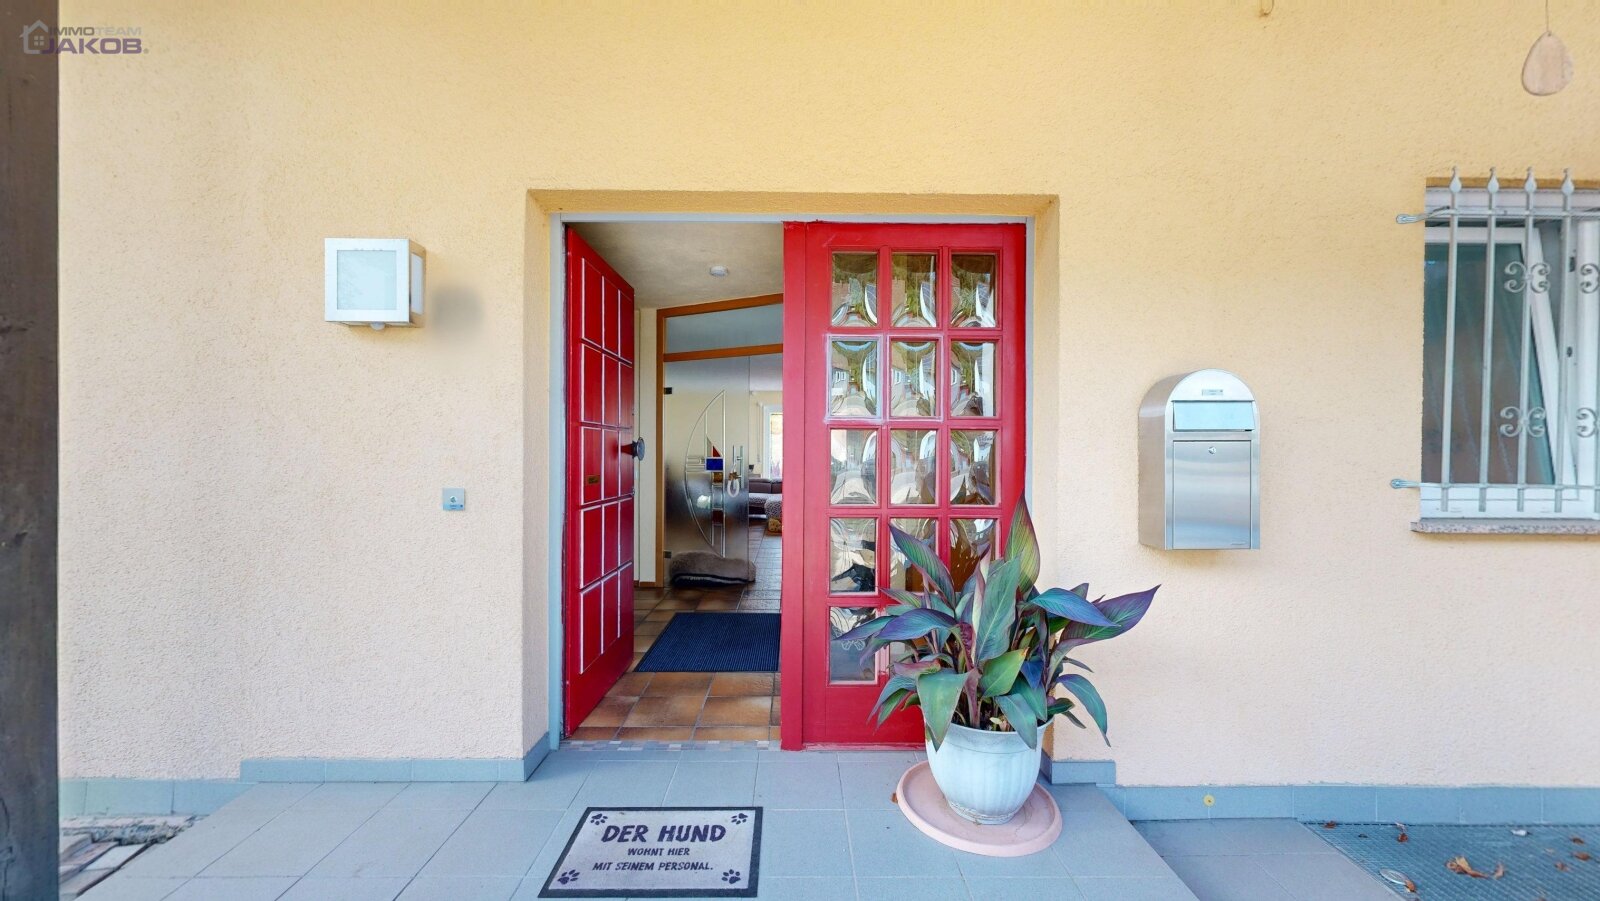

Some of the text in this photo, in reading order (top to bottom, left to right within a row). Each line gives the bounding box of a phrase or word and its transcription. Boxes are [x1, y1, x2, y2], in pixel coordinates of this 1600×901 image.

[601, 825, 726, 842] DER HUND
[627, 848, 690, 856] WOHNT HIER
[592, 862, 714, 871] MIT SEINEM PERSONAL.
